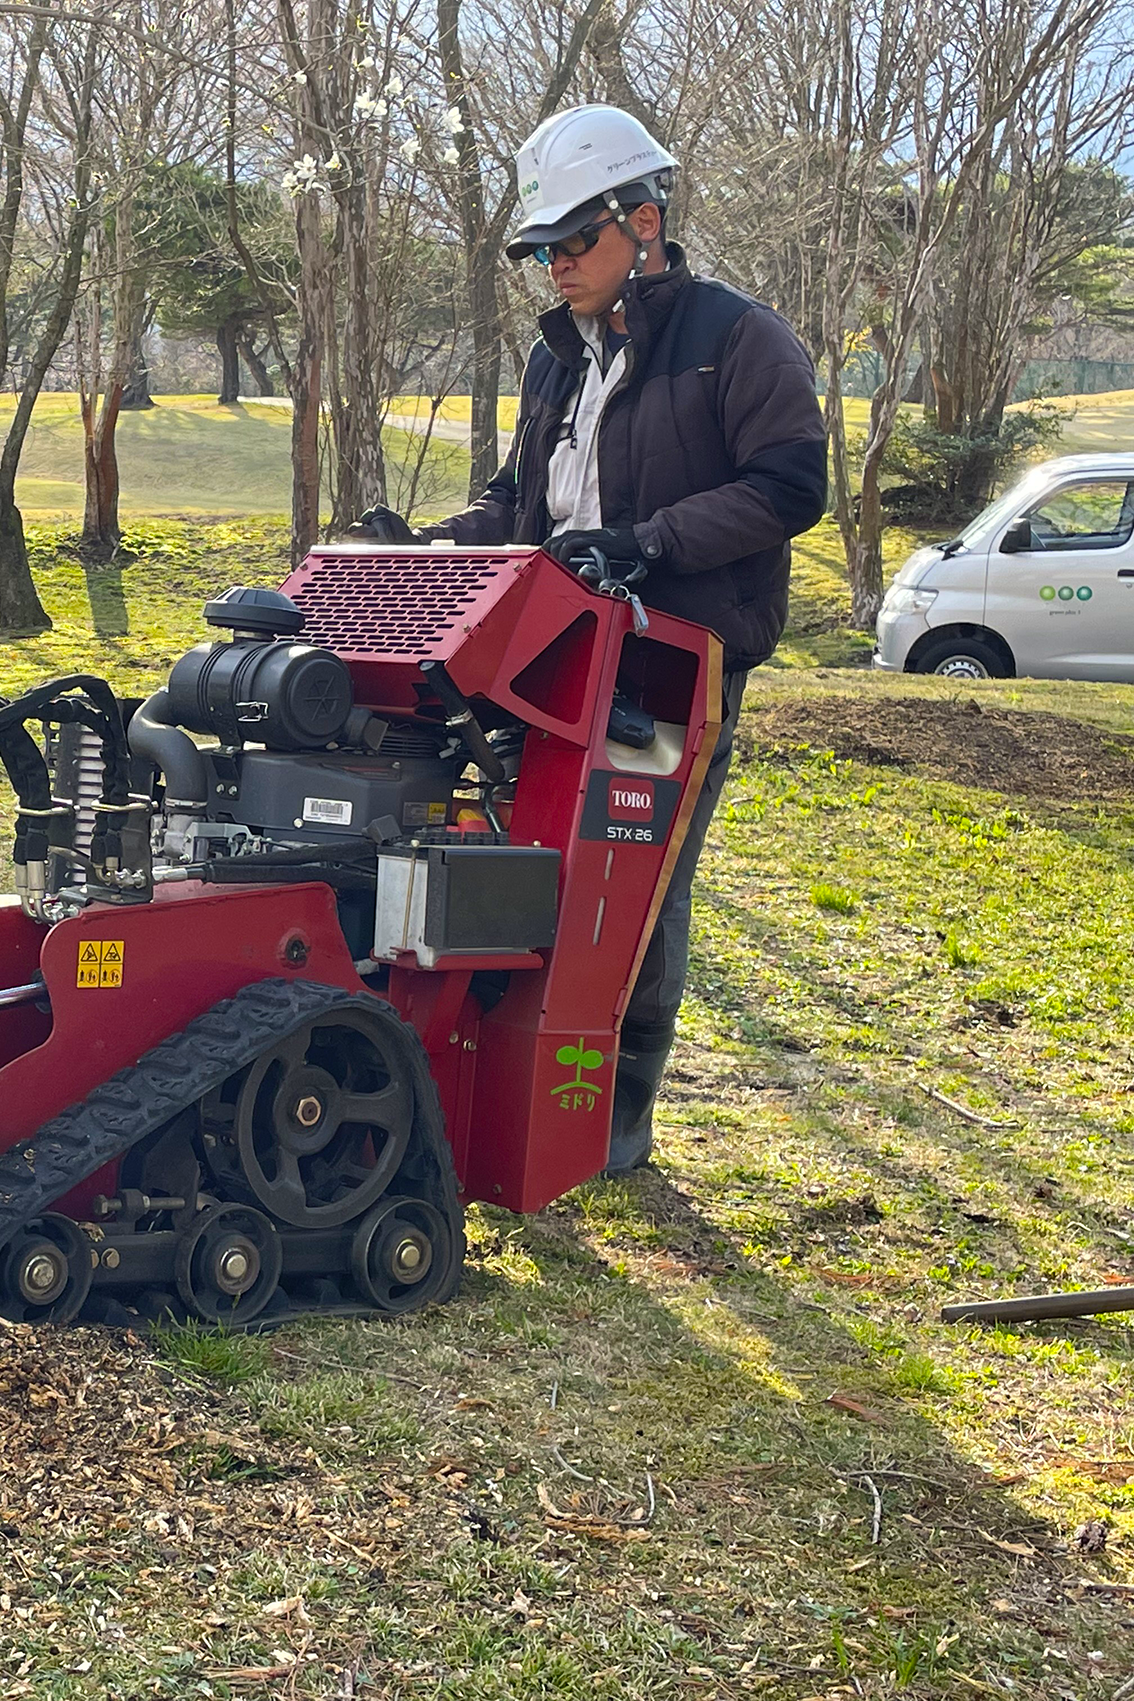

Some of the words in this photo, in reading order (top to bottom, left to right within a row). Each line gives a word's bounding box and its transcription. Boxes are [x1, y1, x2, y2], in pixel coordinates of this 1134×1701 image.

[612, 790, 651, 809] TORO
[559, 1093, 596, 1112] ミドリ
